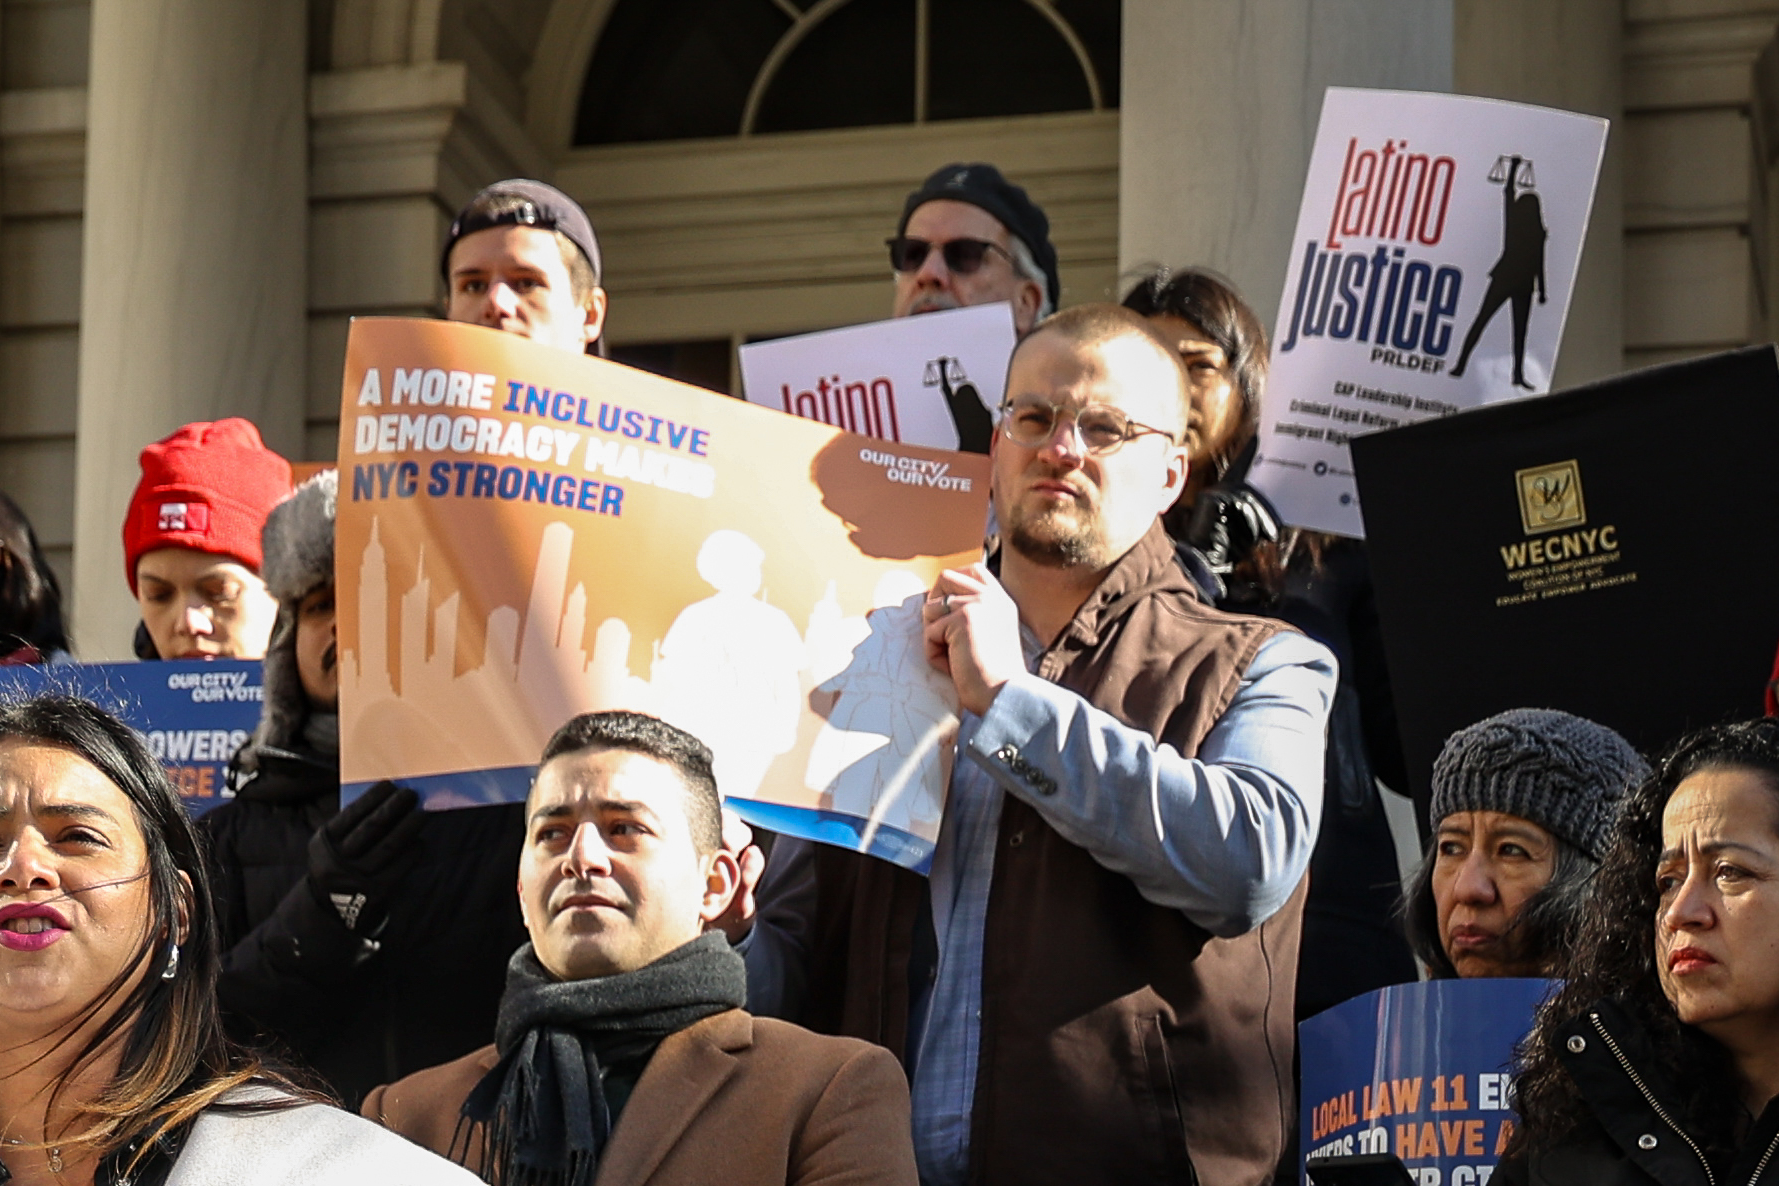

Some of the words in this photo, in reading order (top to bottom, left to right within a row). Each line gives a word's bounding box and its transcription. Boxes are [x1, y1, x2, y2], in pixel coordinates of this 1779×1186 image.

[1280, 241, 1463, 357] Justice
[1371, 348, 1447, 374] PRLDEF
[358, 367, 382, 406] A
[391, 367, 496, 411] MORE
[503, 381, 710, 457] INCLUSIVE
[355, 413, 580, 466] DEMOCRACY
[859, 449, 896, 467] OUR
[353, 461, 419, 502] NYC
[428, 461, 624, 516] STRONGER
[887, 468, 924, 486] OUR
[925, 470, 971, 492] VOTE
[1500, 524, 1619, 570] WECNYC
[168, 673, 201, 690] OUR
[191, 686, 225, 703] OUR
[1312, 1090, 1358, 1141] LOCAL
[1362, 1077, 1422, 1121] LAW
[1431, 1074, 1469, 1112] 11
[1395, 1120, 1485, 1160] HAVE
